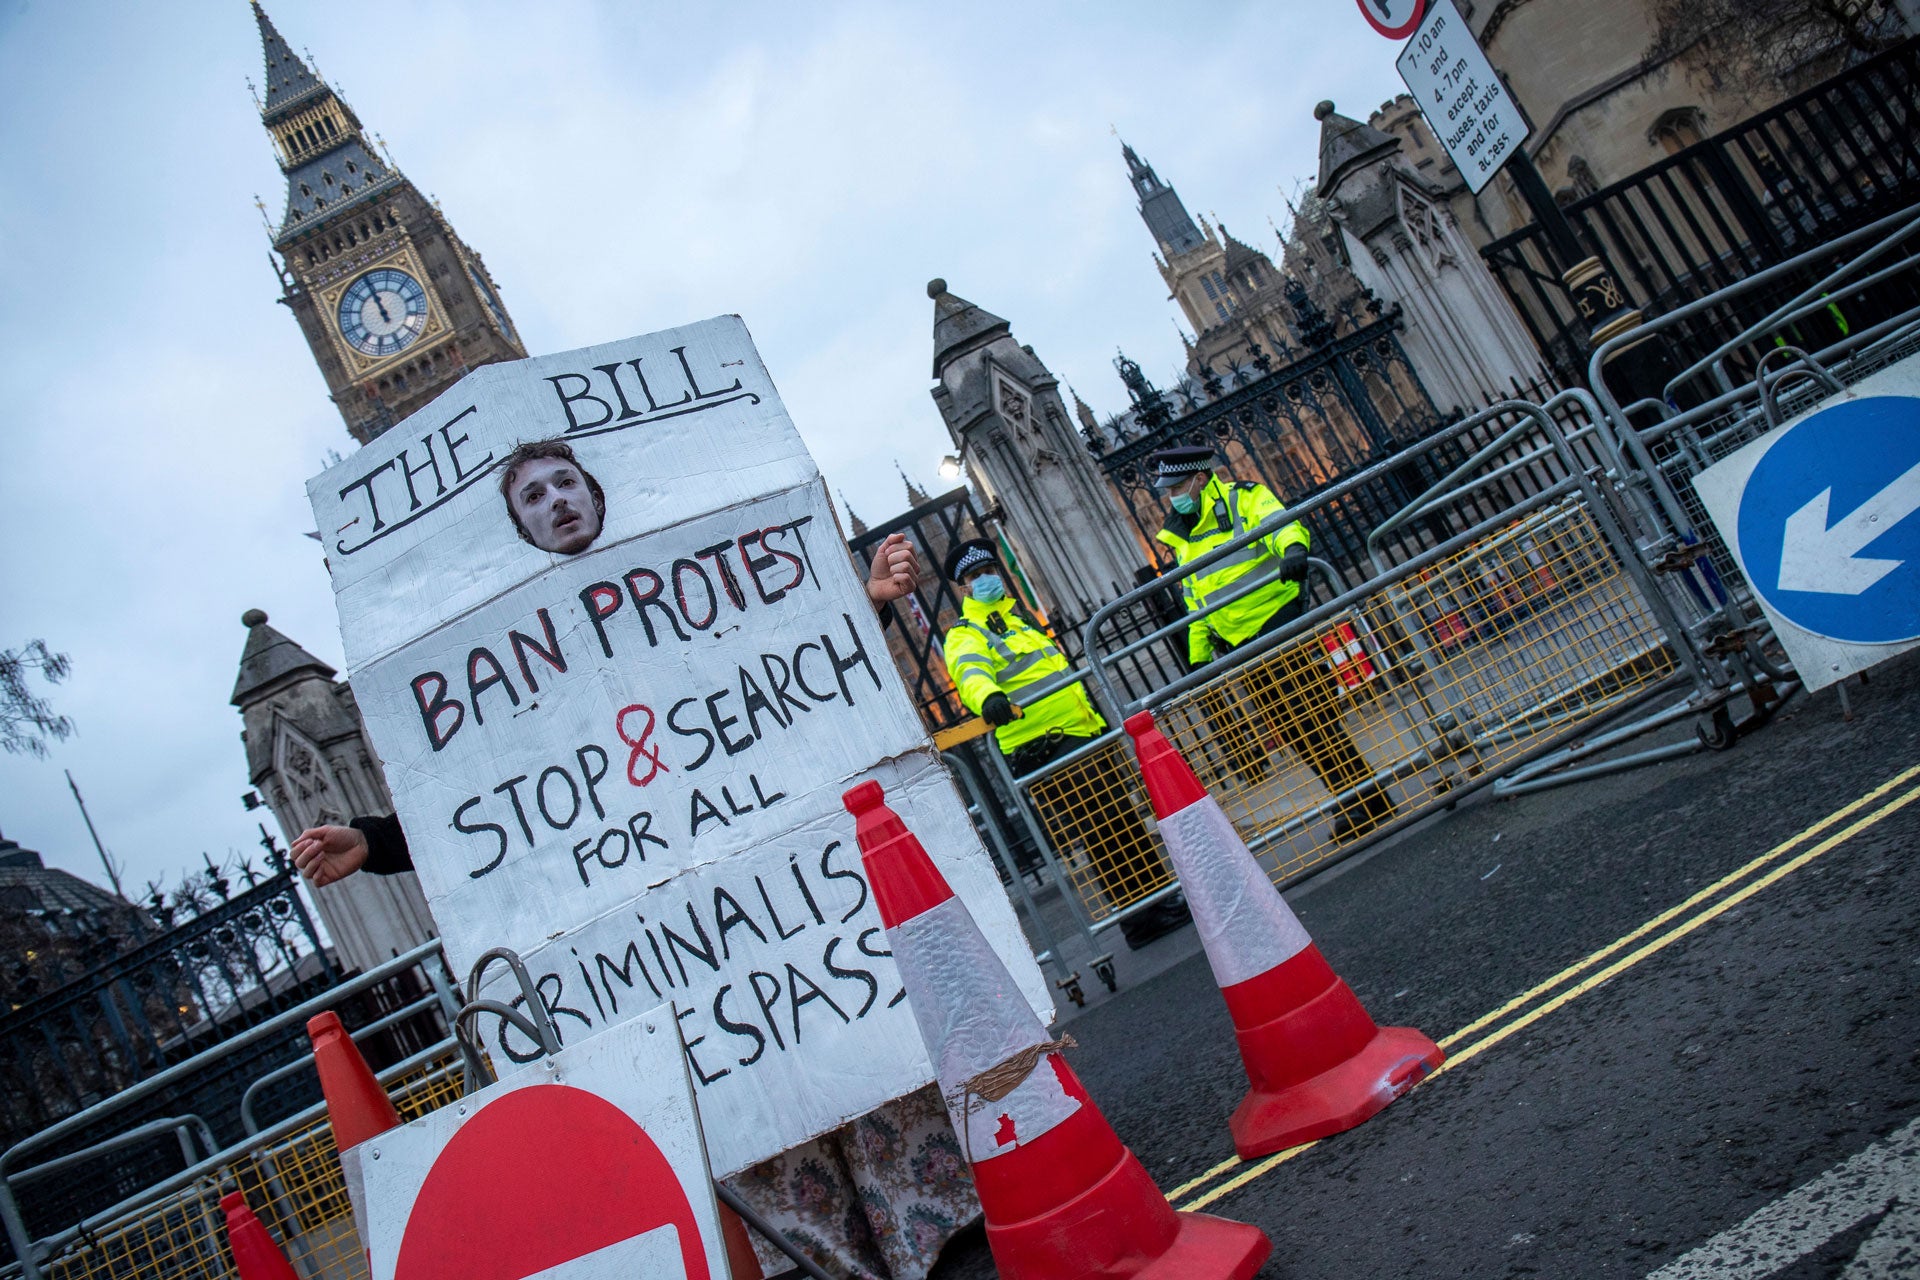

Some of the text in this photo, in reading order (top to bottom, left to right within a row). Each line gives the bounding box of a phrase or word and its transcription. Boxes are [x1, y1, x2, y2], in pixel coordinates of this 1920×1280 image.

[1430, 16, 1446, 39] am
[1430, 45, 1448, 75] and
[1451, 58, 1468, 84] pm
[1447, 77, 1478, 121] except
[1473, 83, 1499, 115] taxis
[1467, 113, 1499, 156] and for
[339, 346, 744, 533] THE BILL
[410, 515, 821, 752] BAN PROTEST
[449, 613, 883, 879] STOP & SEARCH
[572, 774, 786, 888] FOR ALL
